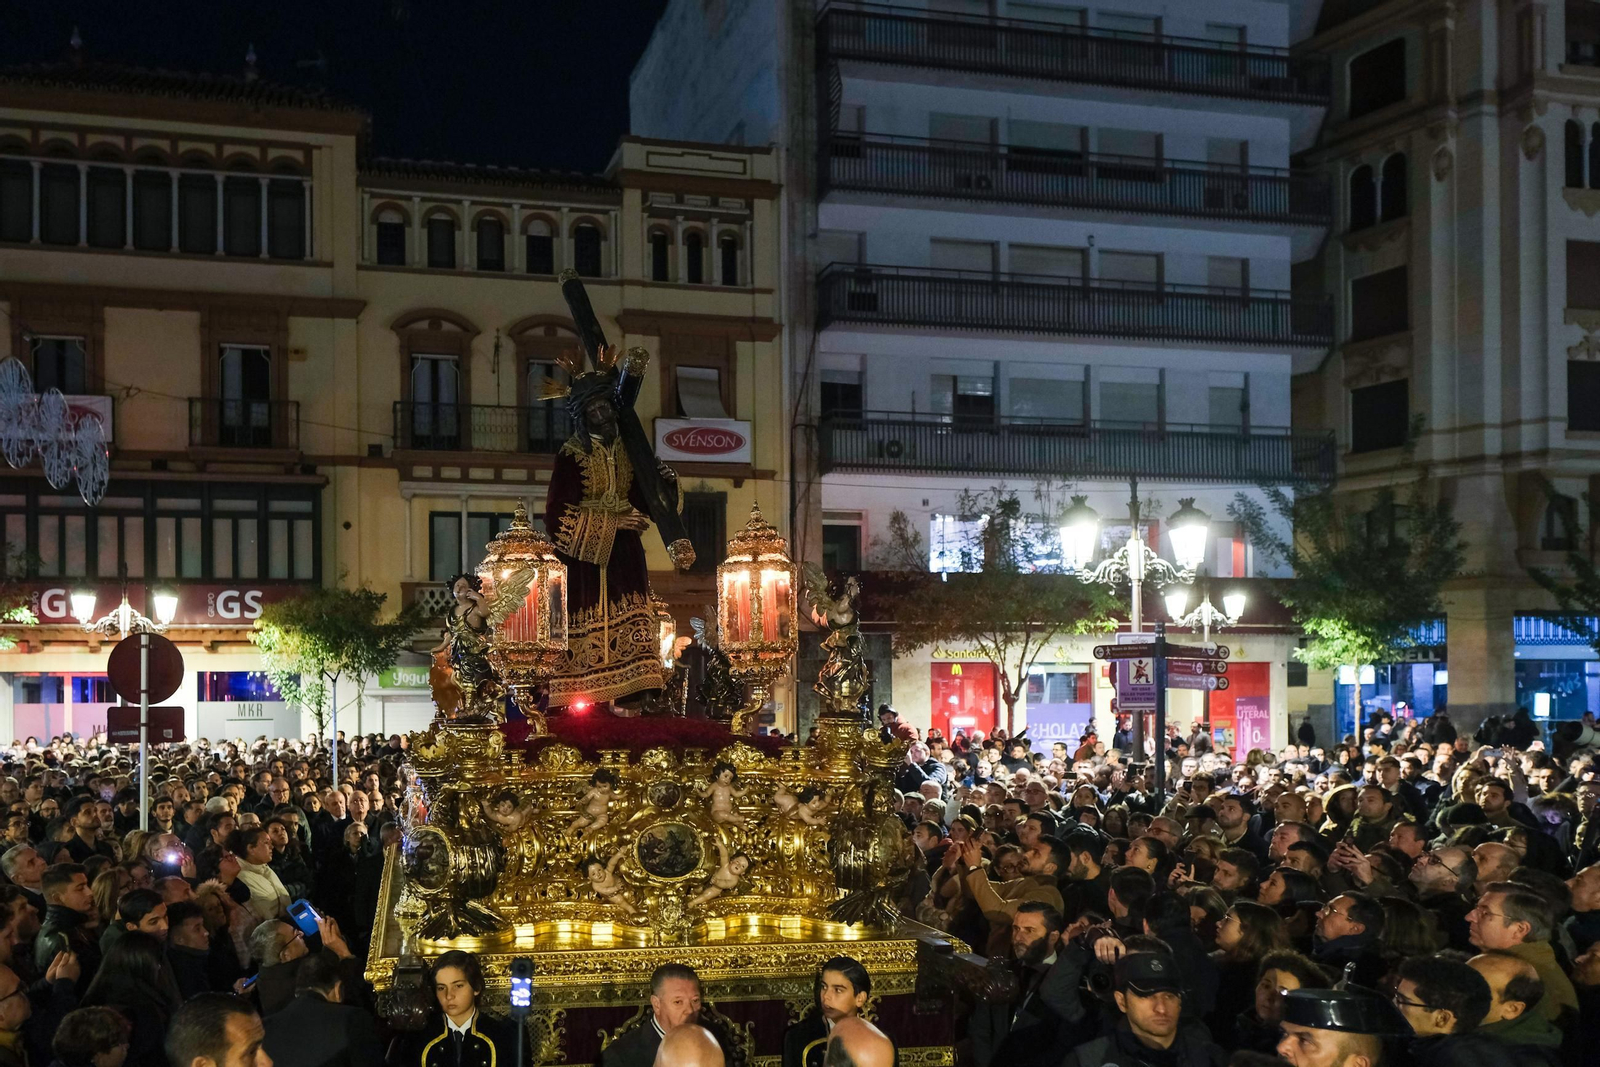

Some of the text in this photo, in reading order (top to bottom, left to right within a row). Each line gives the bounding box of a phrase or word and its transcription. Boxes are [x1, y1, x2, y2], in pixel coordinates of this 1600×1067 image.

[671, 433, 737, 448] SVENSON
[40, 588, 76, 619] G
[207, 589, 264, 619] GRUPO GS
[946, 647, 999, 659] Santand
[237, 703, 263, 717] MKR
[1031, 723, 1087, 738] ¿HOLA?
